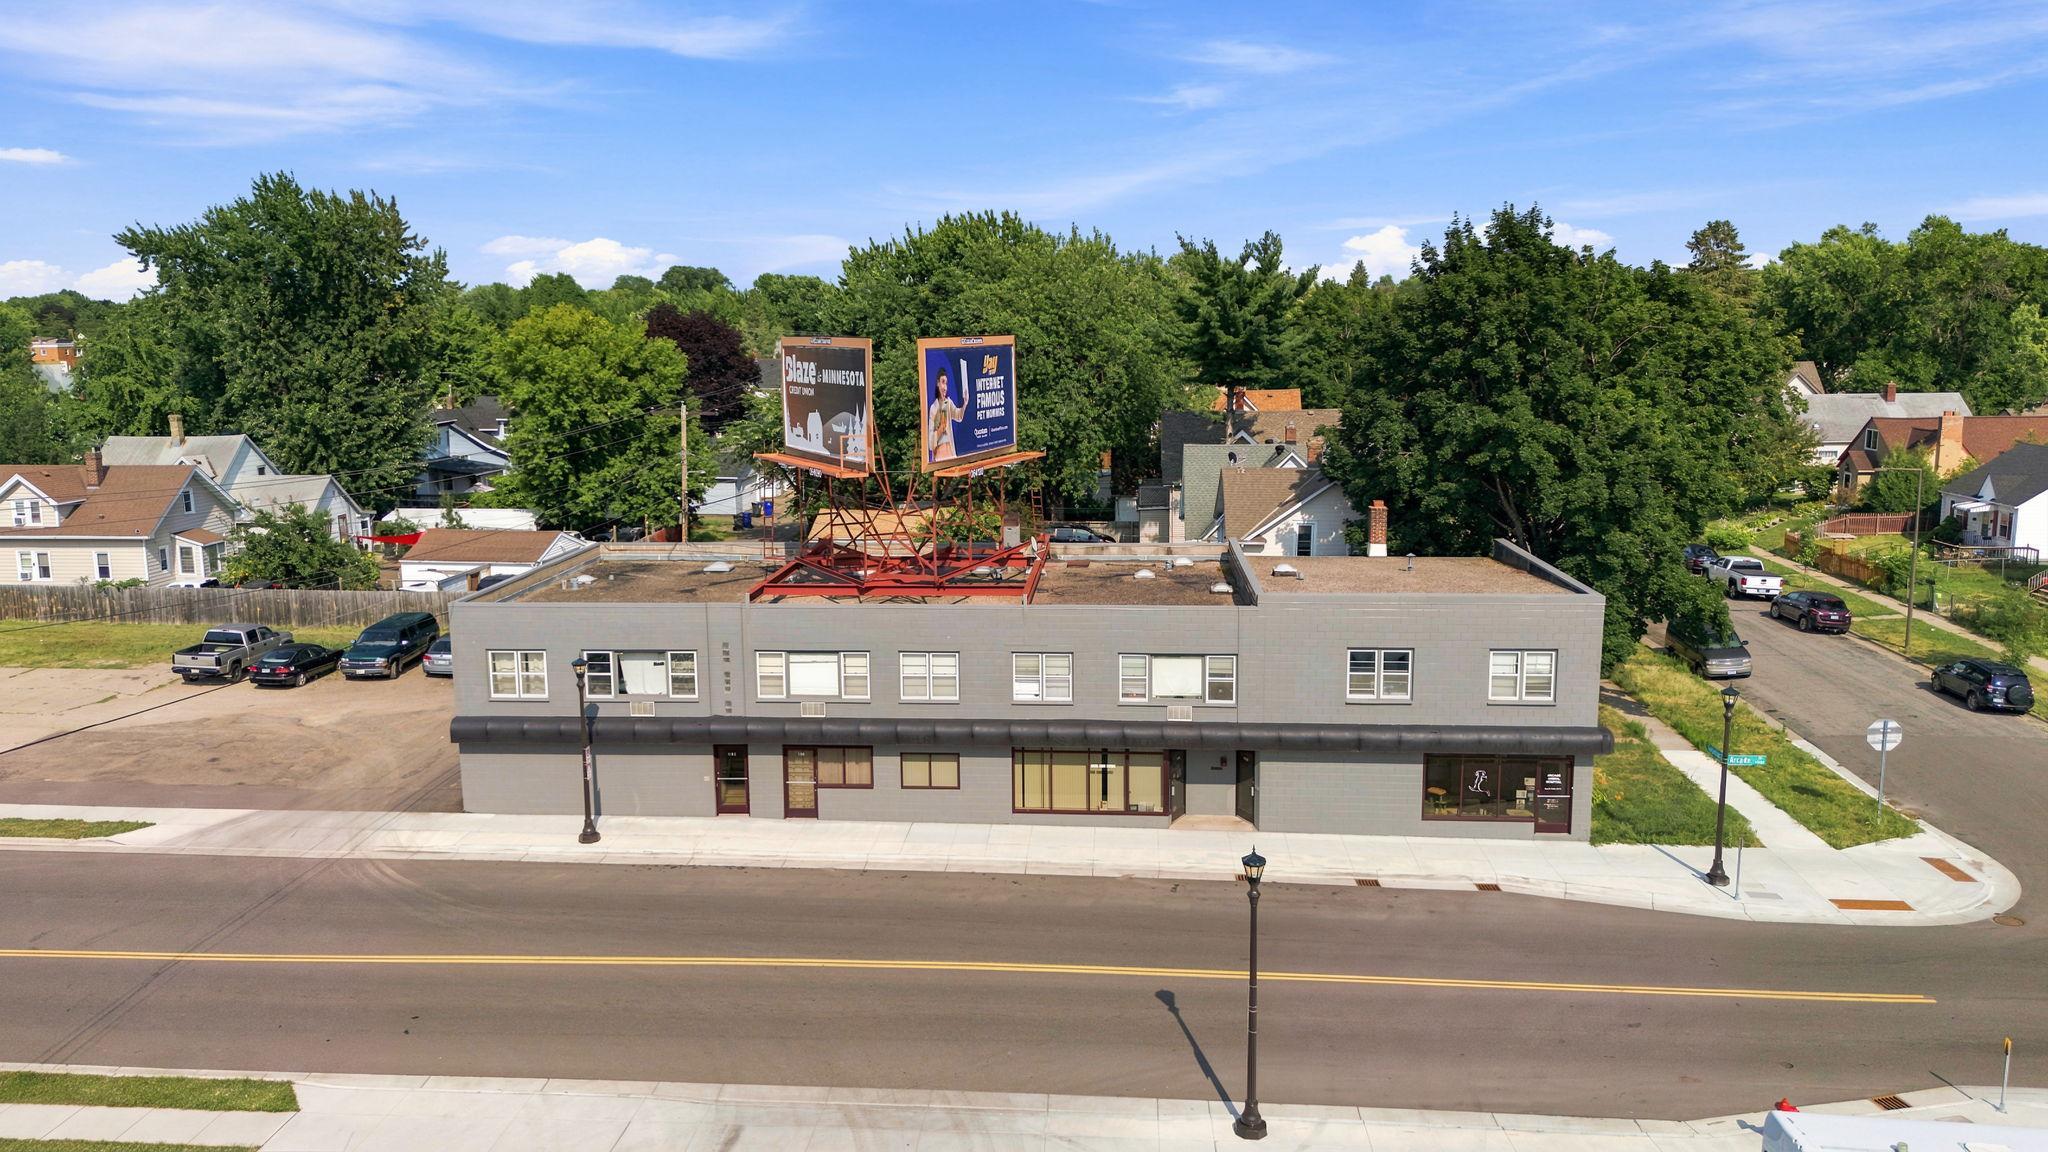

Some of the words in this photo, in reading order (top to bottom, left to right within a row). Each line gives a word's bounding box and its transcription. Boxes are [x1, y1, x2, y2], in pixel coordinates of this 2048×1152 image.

[785, 354, 816, 385] Blaze
[822, 369, 865, 387] MINNESOTA
[788, 385, 802, 395] CREDIT
[801, 387, 815, 396] UNION
[975, 376, 1004, 391] INTERNET
[976, 390, 1005, 409] FAMOUS
[976, 410, 985, 420] PET
